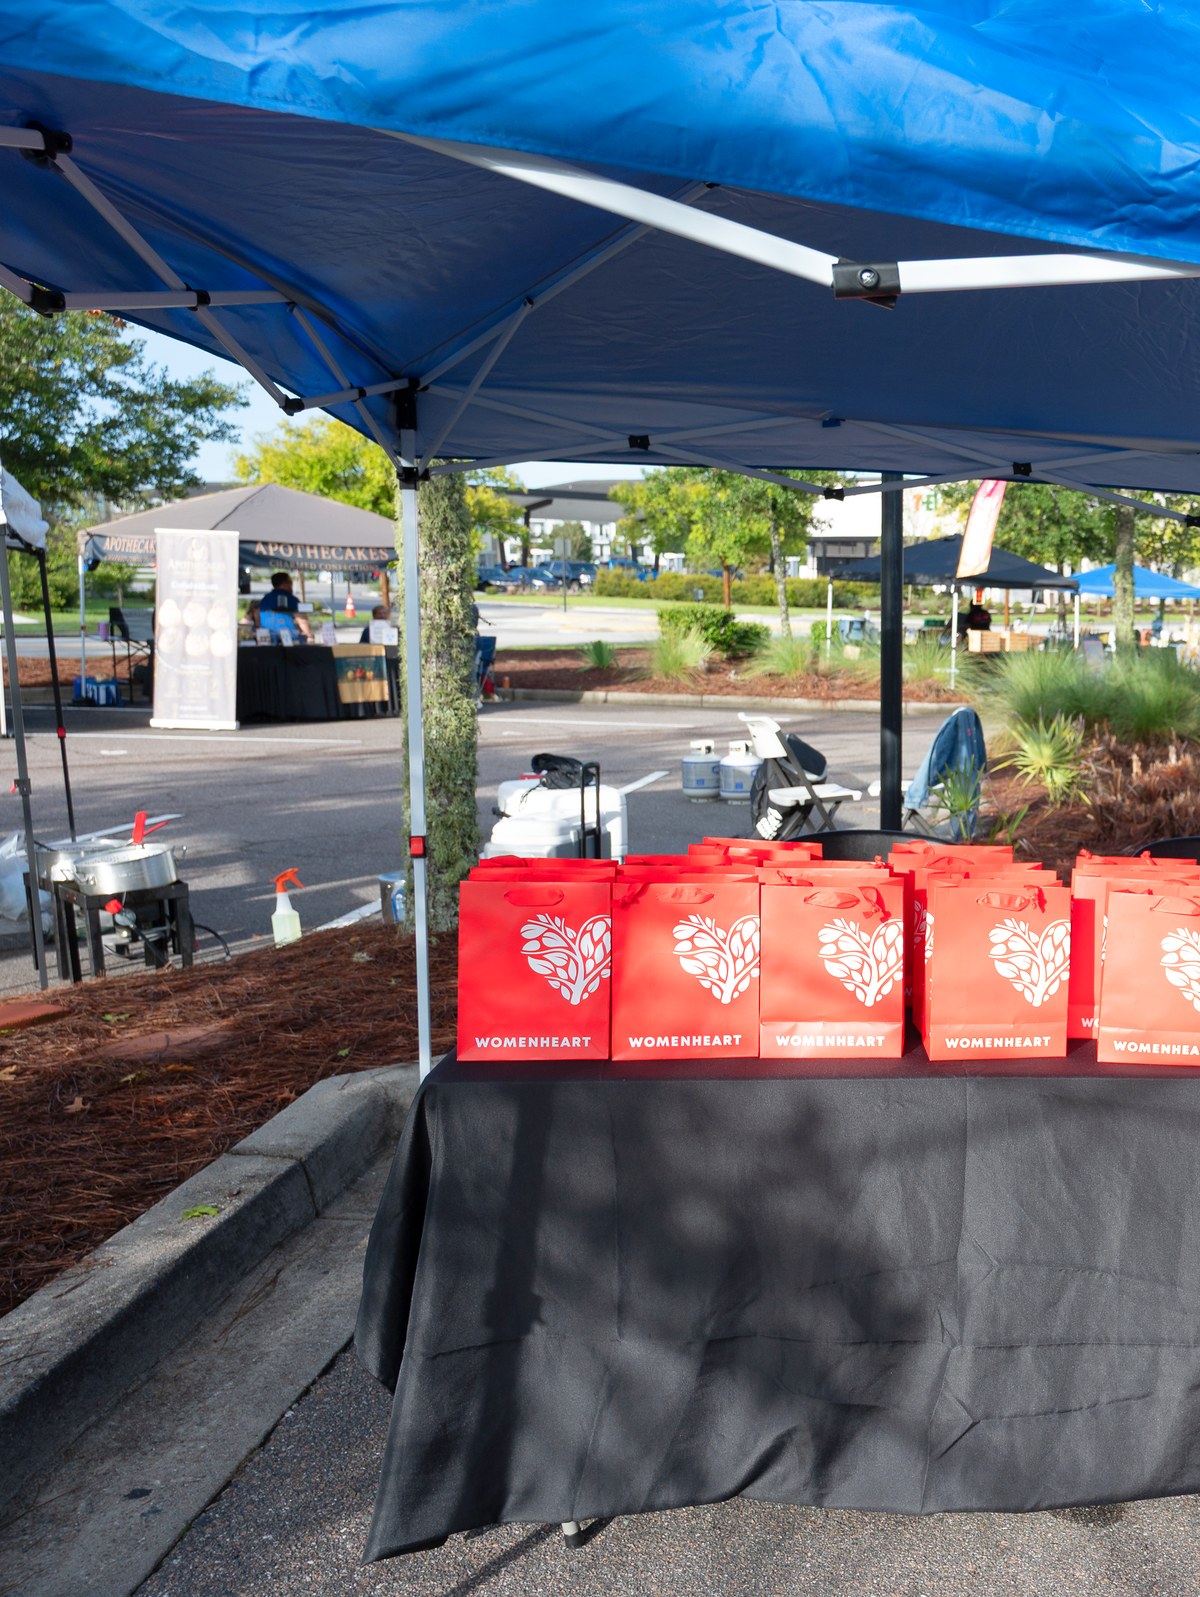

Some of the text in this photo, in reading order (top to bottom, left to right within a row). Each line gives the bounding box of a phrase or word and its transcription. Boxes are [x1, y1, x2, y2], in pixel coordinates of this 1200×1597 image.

[254, 541, 390, 562] APOTHECAKES
[268, 558, 380, 571] CHARMED CONFECTIONS
[475, 1036, 591, 1048] WOMENHEART
[628, 1034, 742, 1048] WOMENHEART
[776, 1035, 885, 1048] WOMENHEART
[945, 1036, 1051, 1049] WOMENHEART
